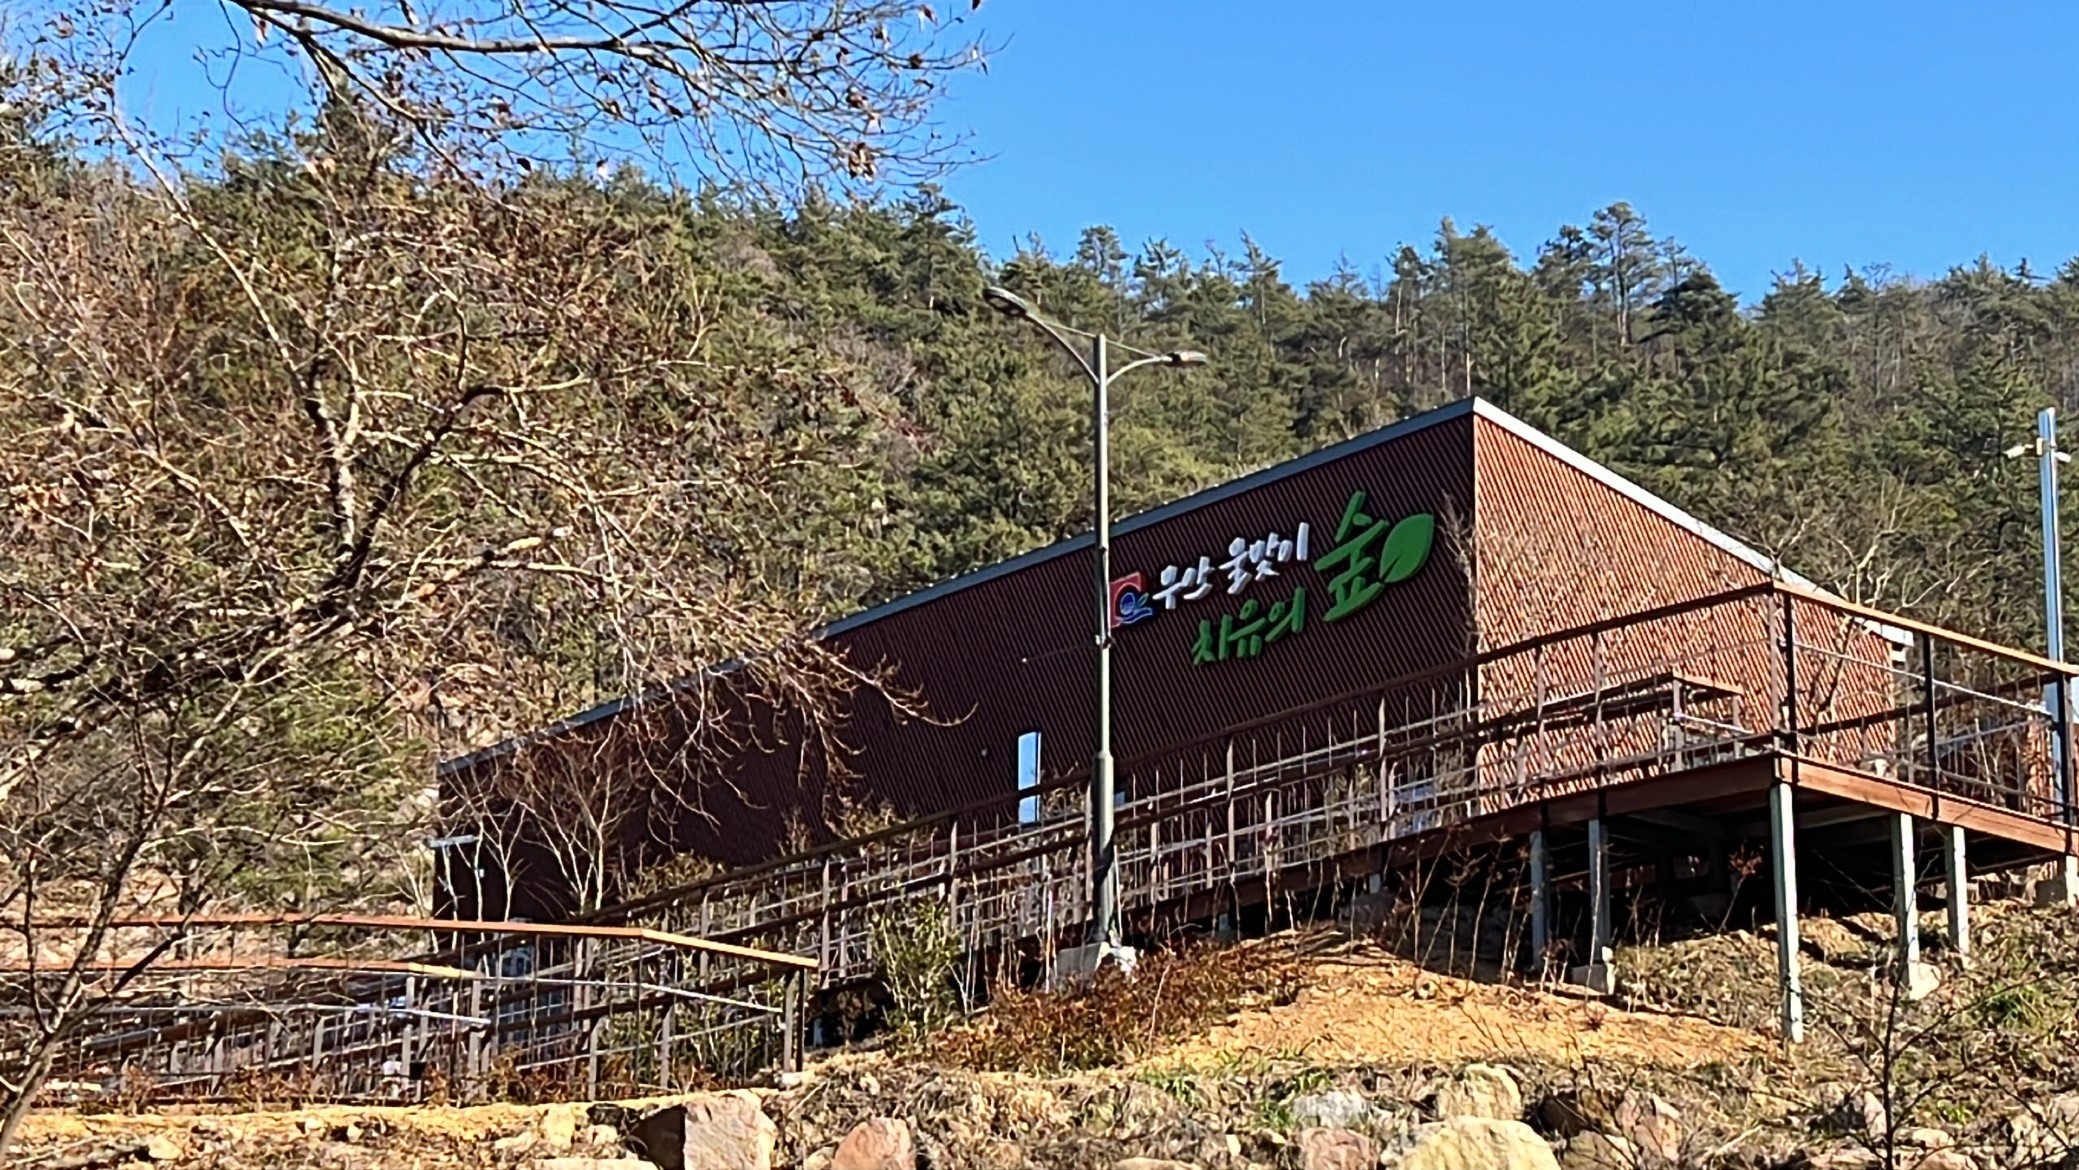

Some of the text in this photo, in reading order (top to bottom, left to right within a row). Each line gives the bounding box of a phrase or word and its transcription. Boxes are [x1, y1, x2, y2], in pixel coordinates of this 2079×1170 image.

[1152, 556, 1215, 609] 무안
[1191, 490, 1389, 665] 치유의 숲
